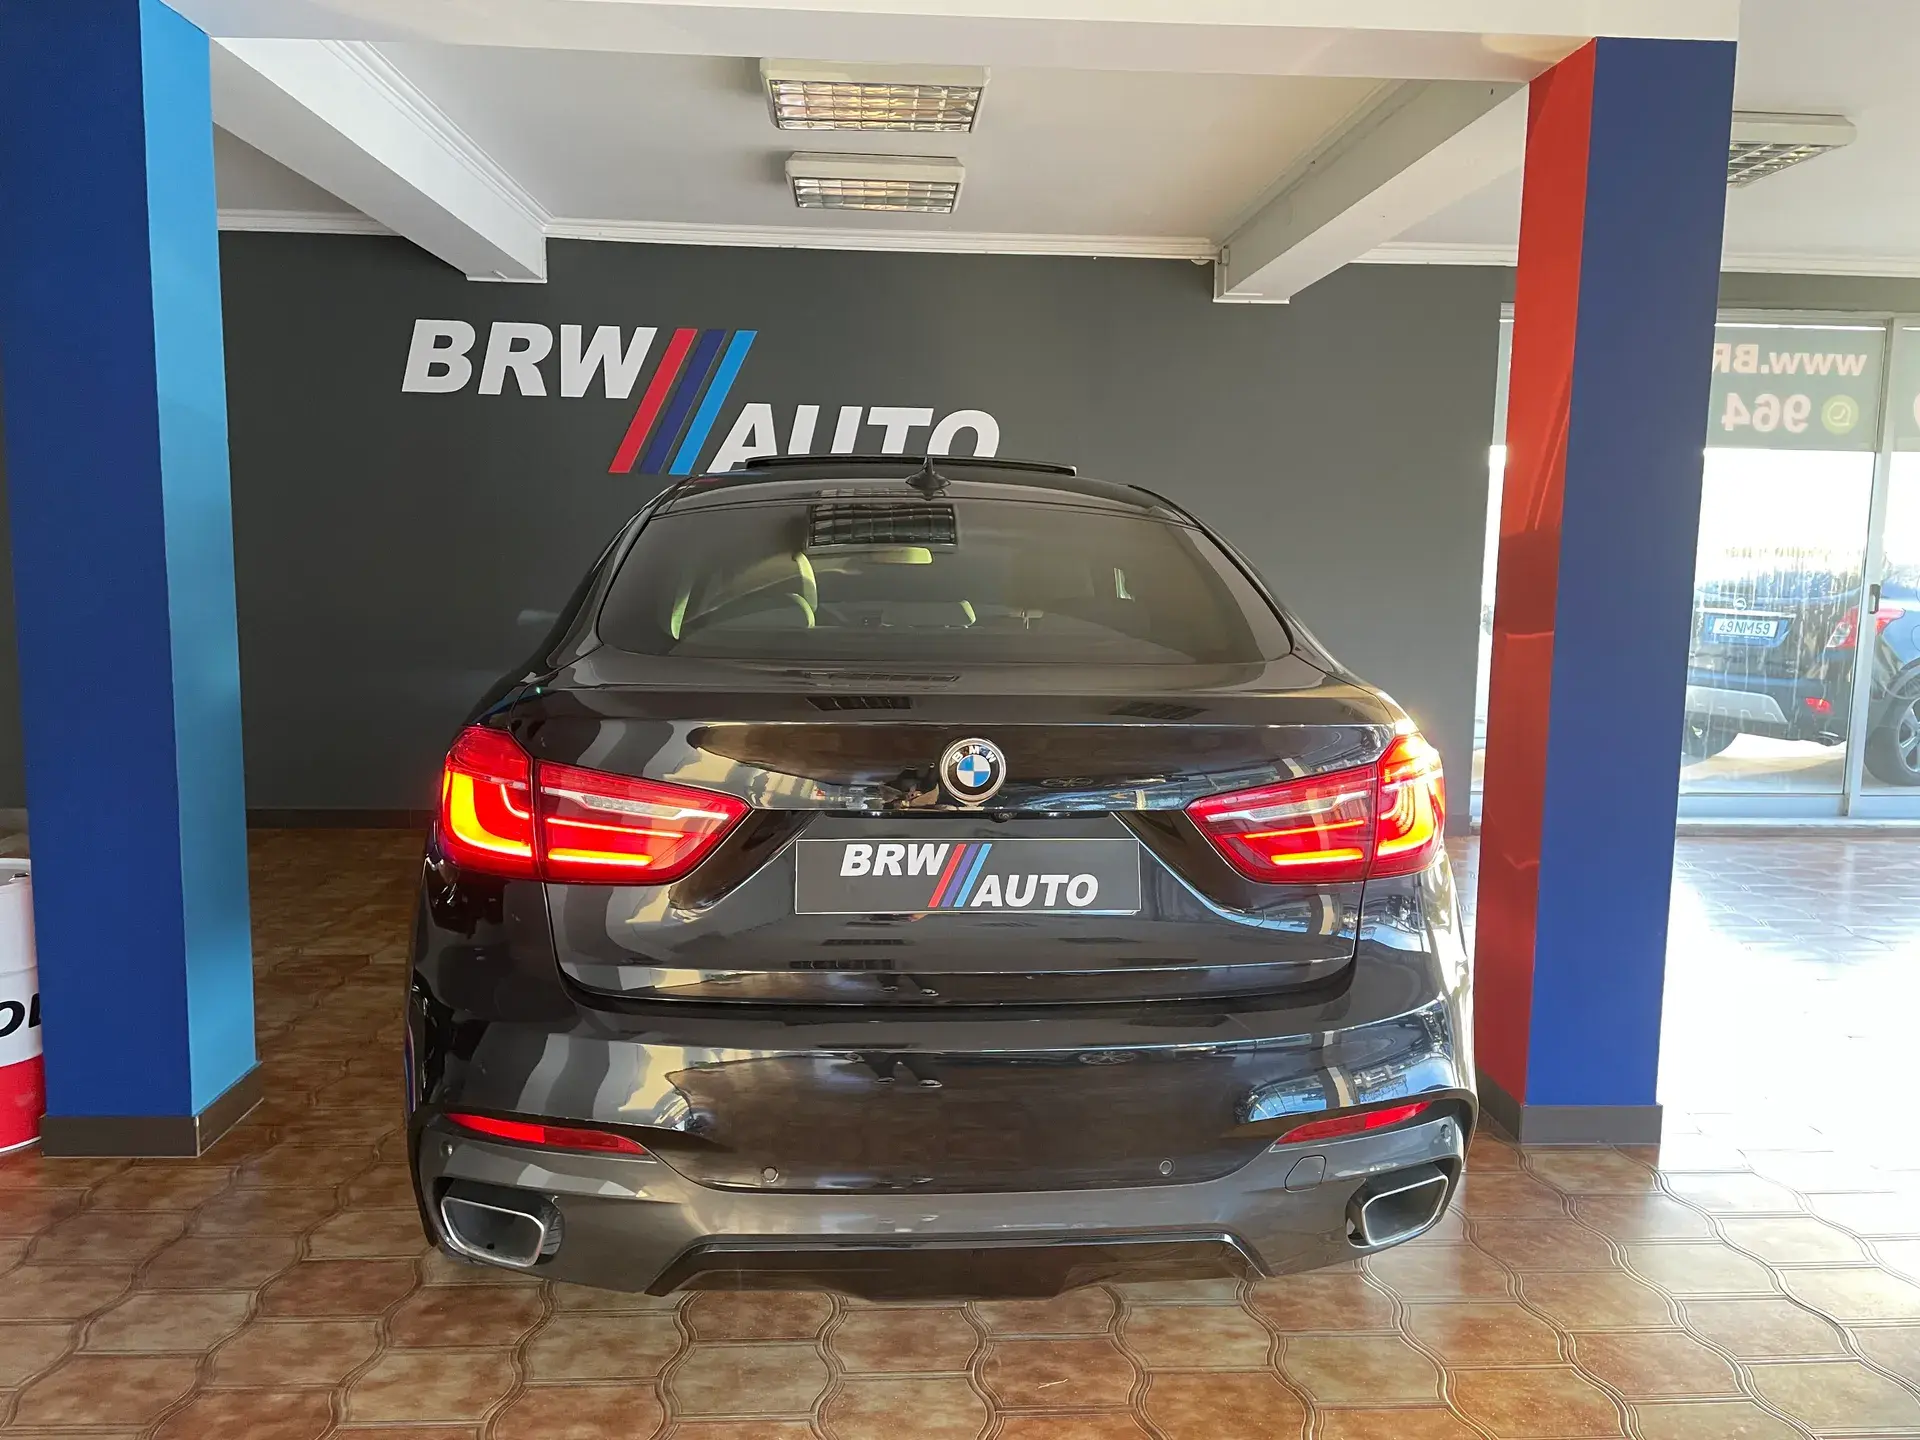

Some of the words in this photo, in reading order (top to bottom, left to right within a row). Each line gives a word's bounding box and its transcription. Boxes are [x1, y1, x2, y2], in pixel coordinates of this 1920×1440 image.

[401, 318, 658, 399] BRW
[706, 402, 1001, 473] AUTO
[951, 745, 997, 763] BMW
[839, 843, 950, 877] BRW
[969, 873, 1100, 908] AUTO
